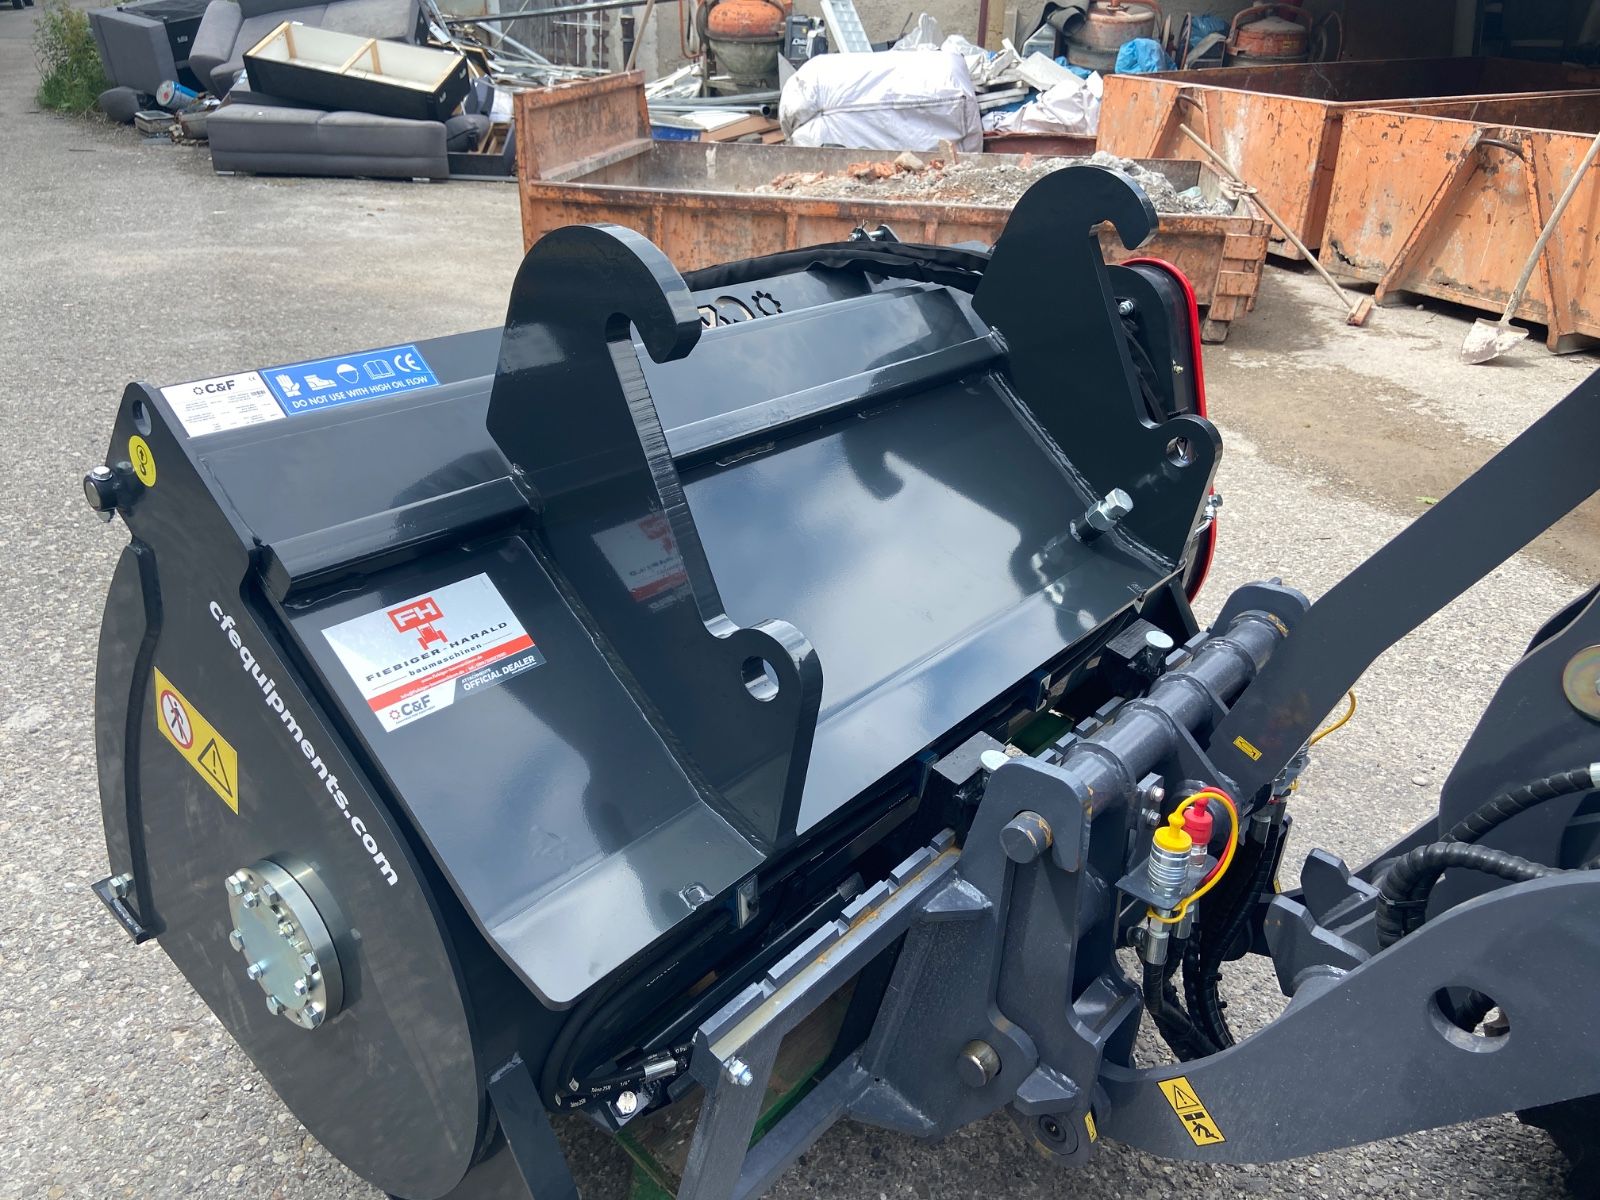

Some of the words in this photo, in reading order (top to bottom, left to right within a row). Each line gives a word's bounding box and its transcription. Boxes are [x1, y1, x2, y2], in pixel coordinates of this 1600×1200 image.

[205, 380, 235, 393] C&F
[292, 400, 307, 409] DO
[309, 395, 329, 406] NOT
[329, 392, 347, 402] USE
[347, 388, 369, 398] WITH
[369, 383, 391, 393] HIGH
[392, 380, 406, 389] OIL
[406, 376, 428, 386] FLOW
[393, 602, 437, 627] FH
[408, 643, 482, 676] baumaschinen
[463, 669, 503, 691] OFFICIAL
[502, 655, 536, 675] DEALER
[401, 694, 431, 716] C&F
[209, 600, 399, 886] cfequipments.com
